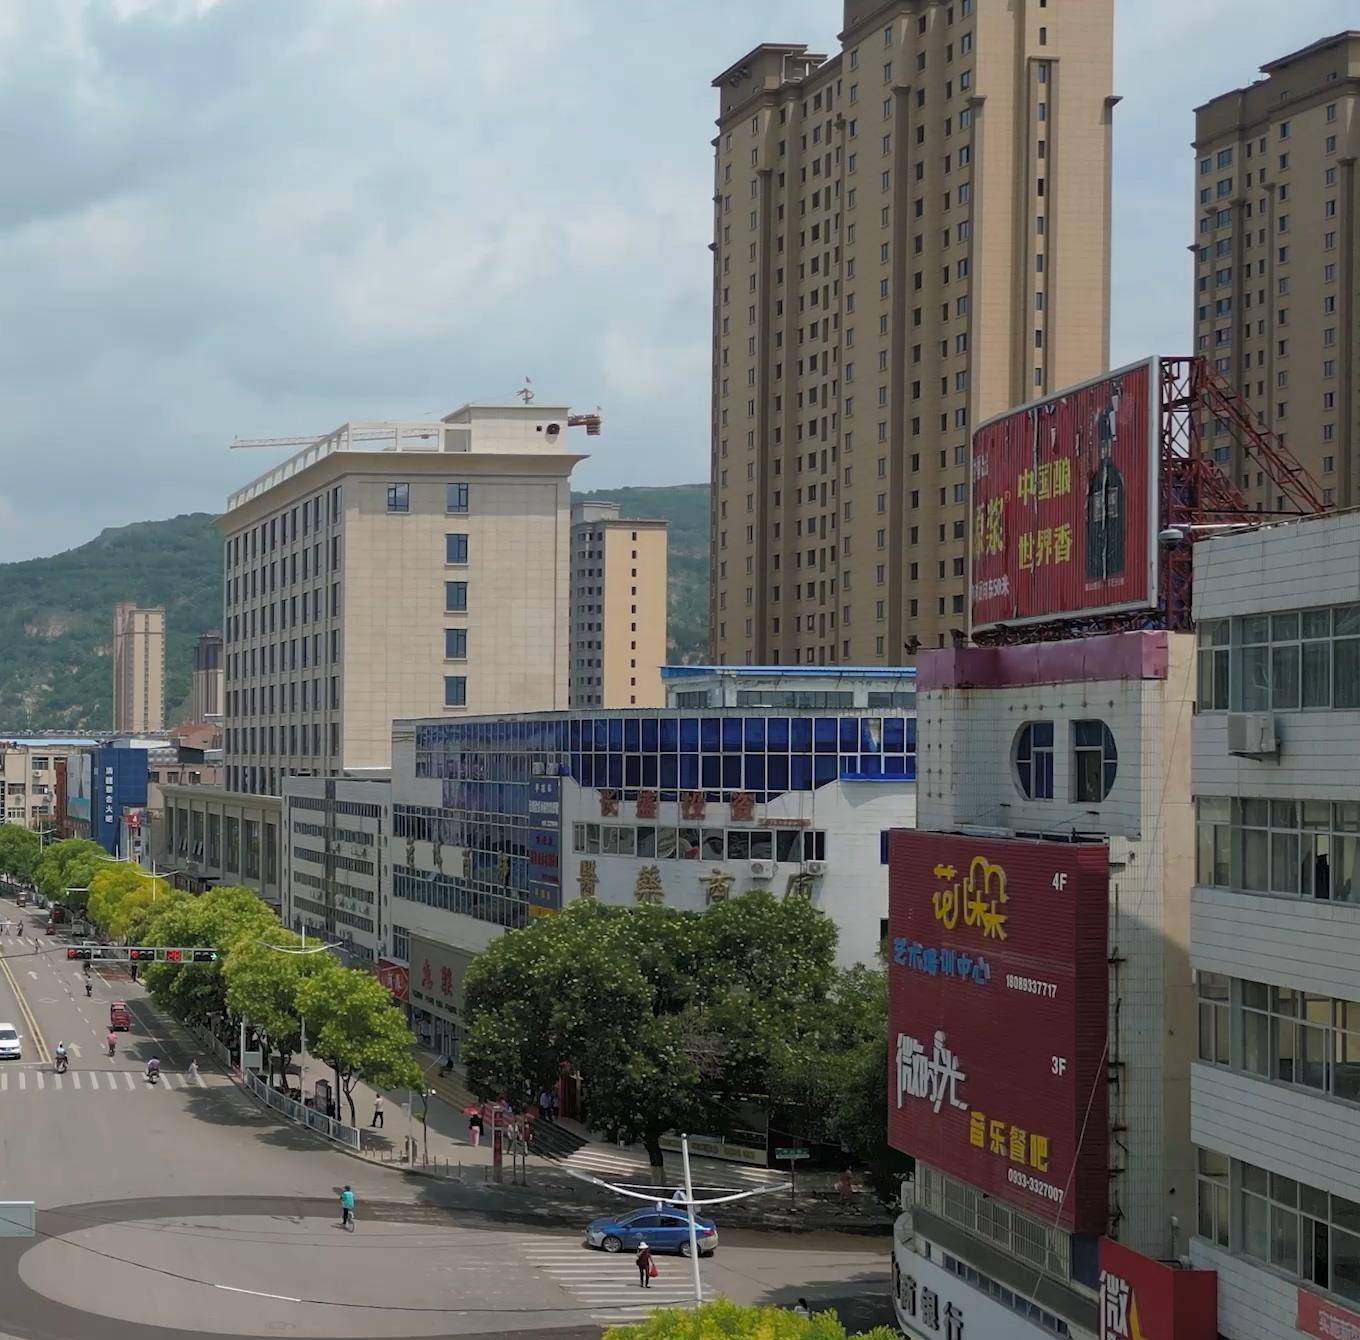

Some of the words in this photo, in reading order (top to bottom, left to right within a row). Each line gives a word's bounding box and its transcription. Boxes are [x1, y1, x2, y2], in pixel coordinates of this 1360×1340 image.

[1052, 872, 1068, 891] 4F
[893, 936, 992, 985] 艺术培训中心
[1051, 1055, 1068, 1077] 3F
[969, 1111, 1050, 1173] 音乐餐吧
